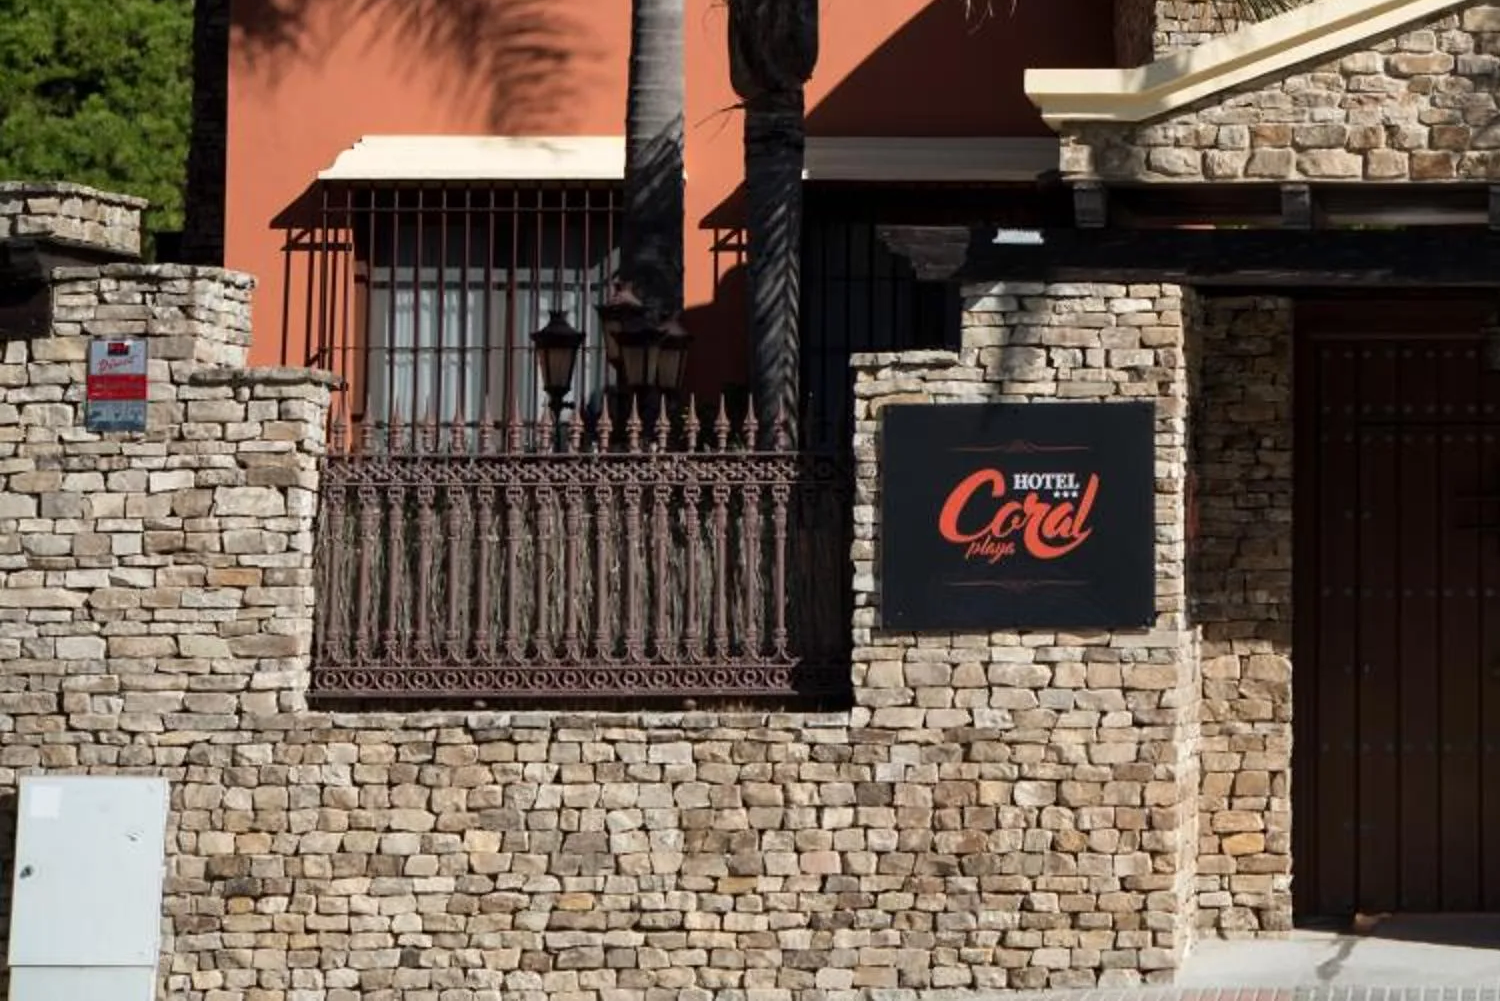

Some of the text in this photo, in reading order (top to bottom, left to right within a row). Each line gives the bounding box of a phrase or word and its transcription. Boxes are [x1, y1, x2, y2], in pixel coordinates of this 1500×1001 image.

[1013, 473, 1080, 490] HOTEL
[938, 468, 1099, 559] Coral
[965, 536, 1016, 565] playa
